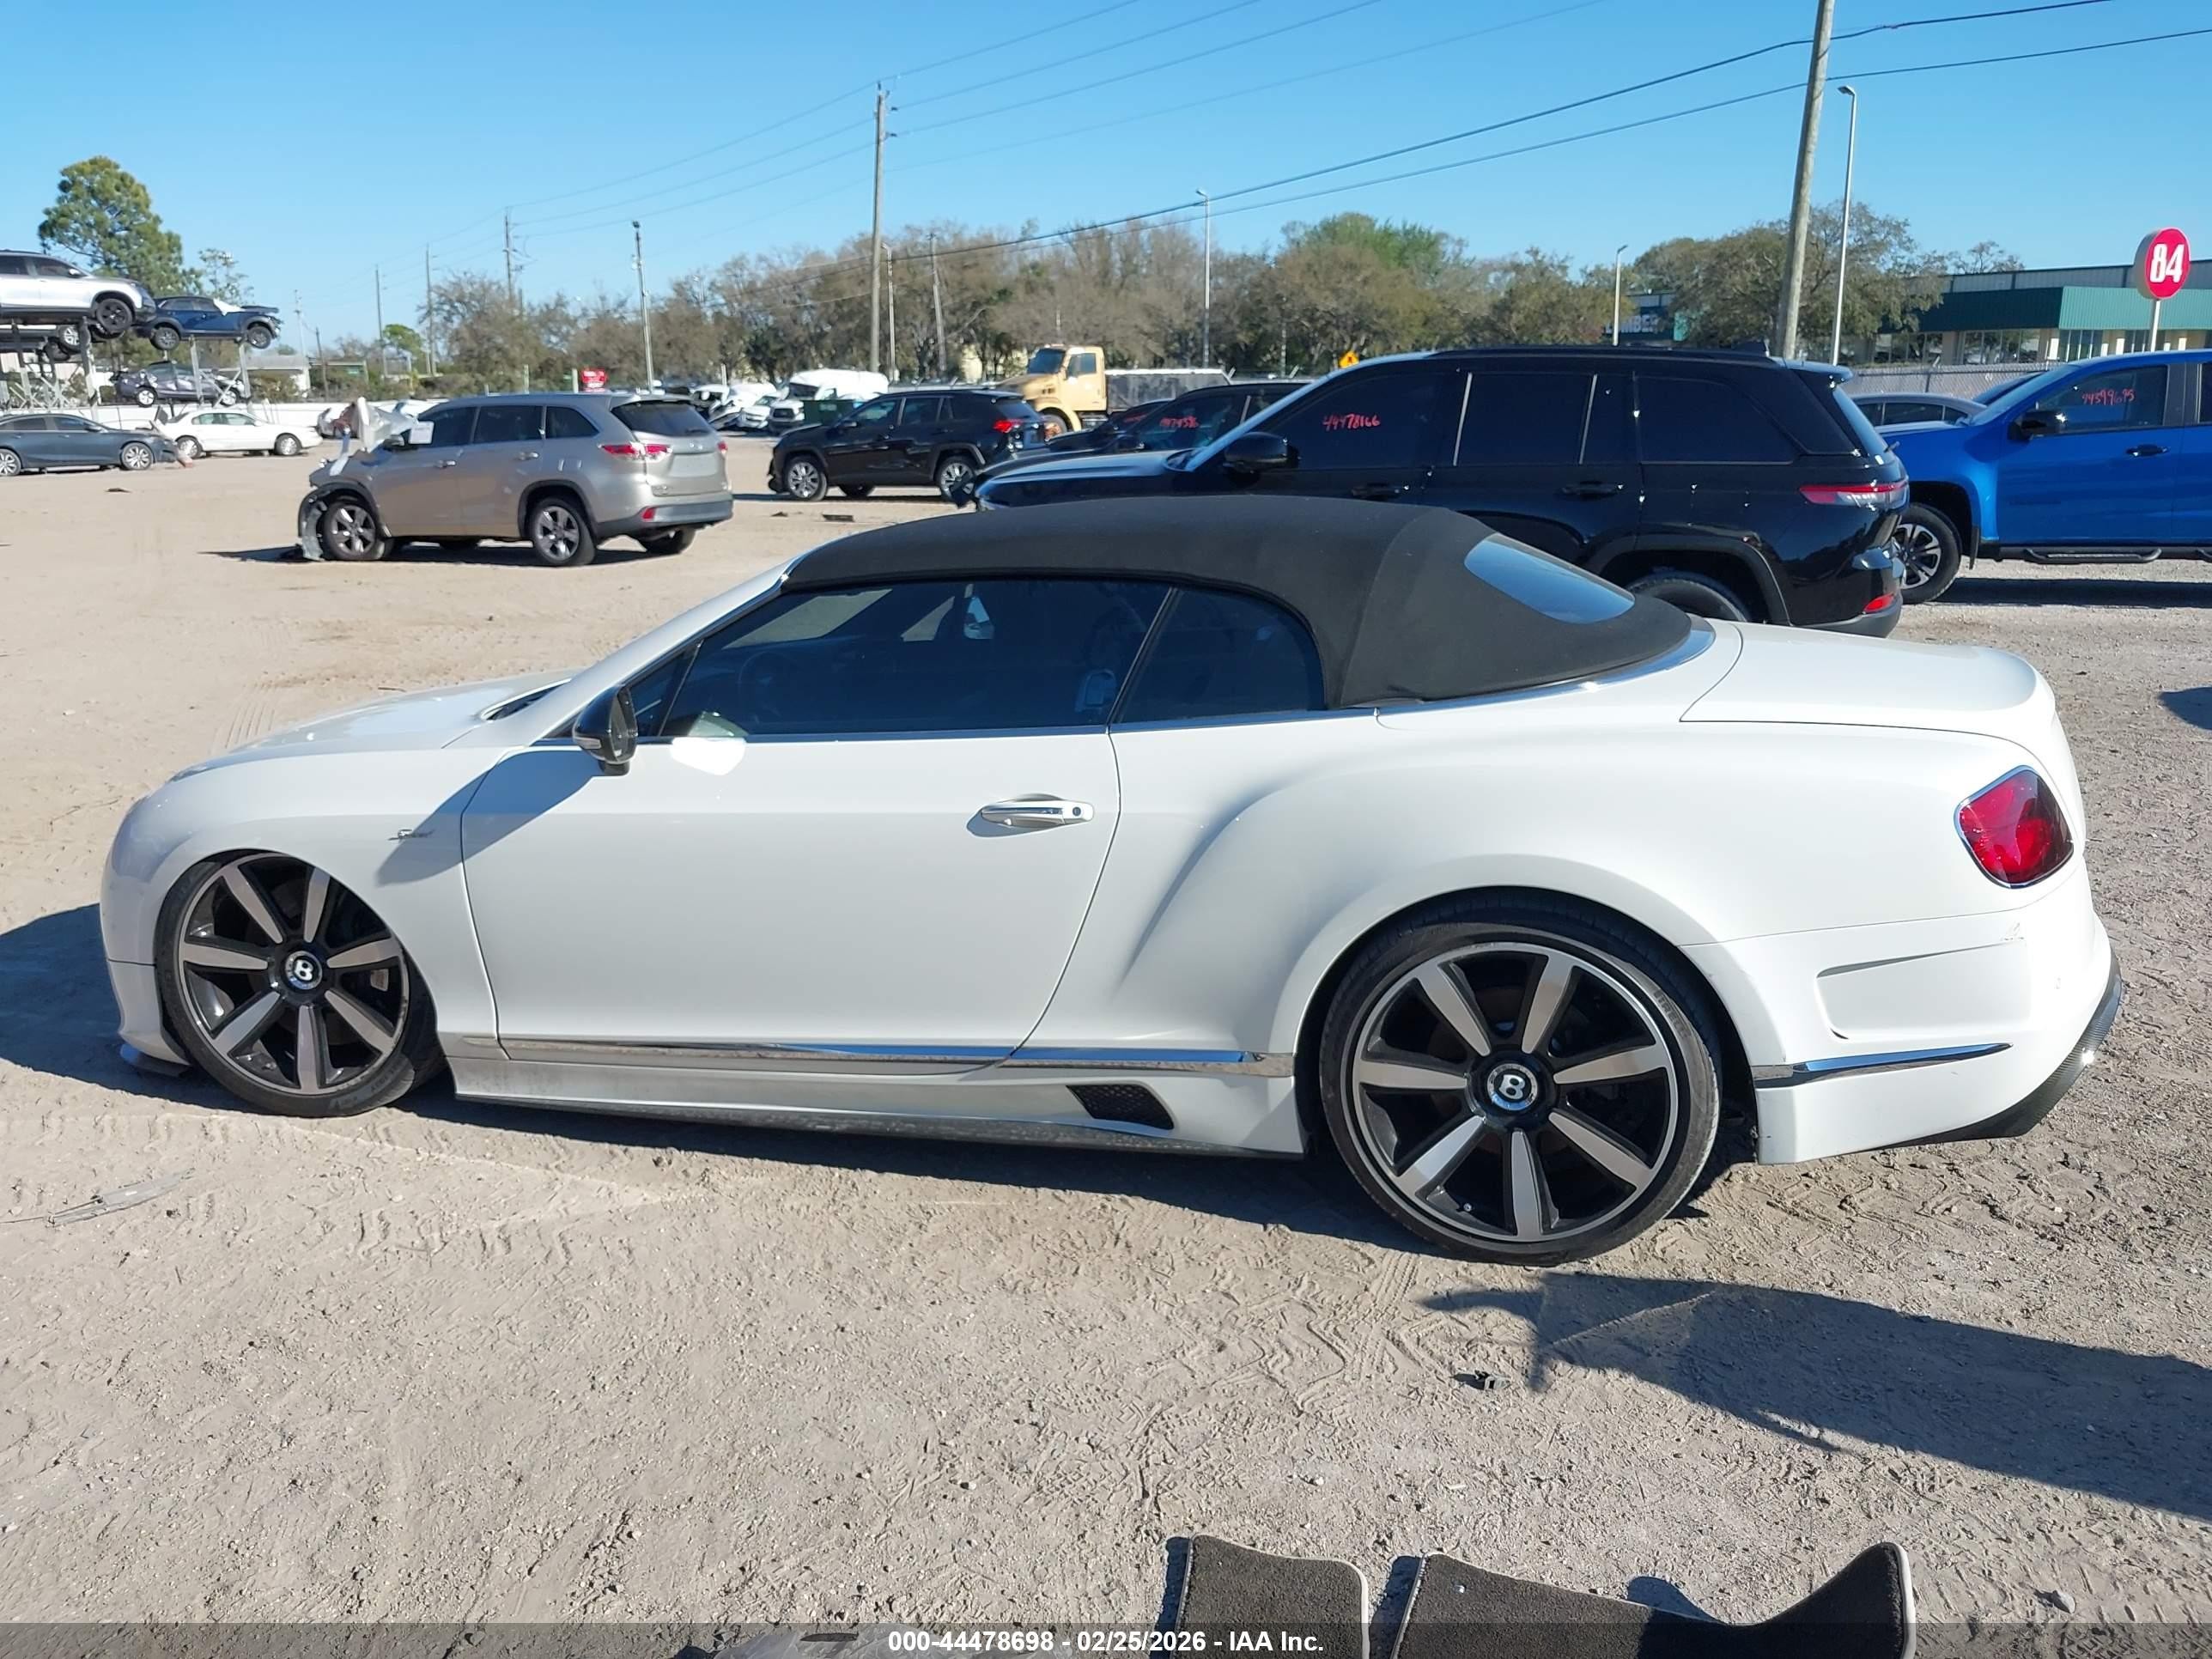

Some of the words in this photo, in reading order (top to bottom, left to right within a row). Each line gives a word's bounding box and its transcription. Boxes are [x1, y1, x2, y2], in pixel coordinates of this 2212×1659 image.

[2149, 243, 2185, 283] 84
[294, 959, 314, 981] B
[1498, 1074, 1526, 1100] B
